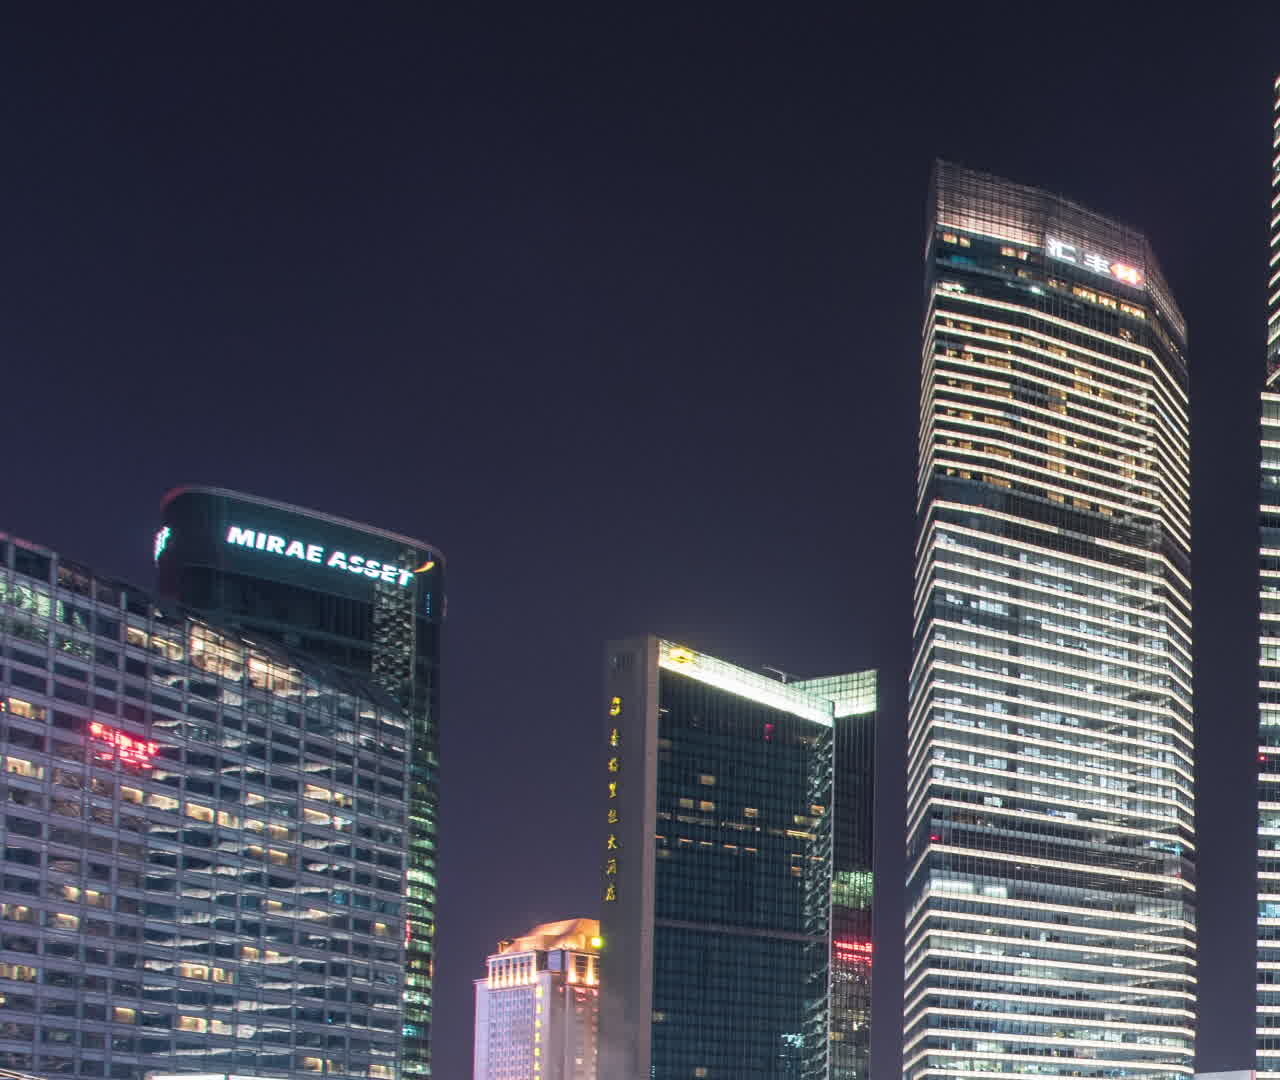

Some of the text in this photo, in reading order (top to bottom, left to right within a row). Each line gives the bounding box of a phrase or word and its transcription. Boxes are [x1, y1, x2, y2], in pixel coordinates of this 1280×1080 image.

[1047, 238, 1111, 273] 汇丰
[227, 526, 414, 586] MIRAE ASSET
